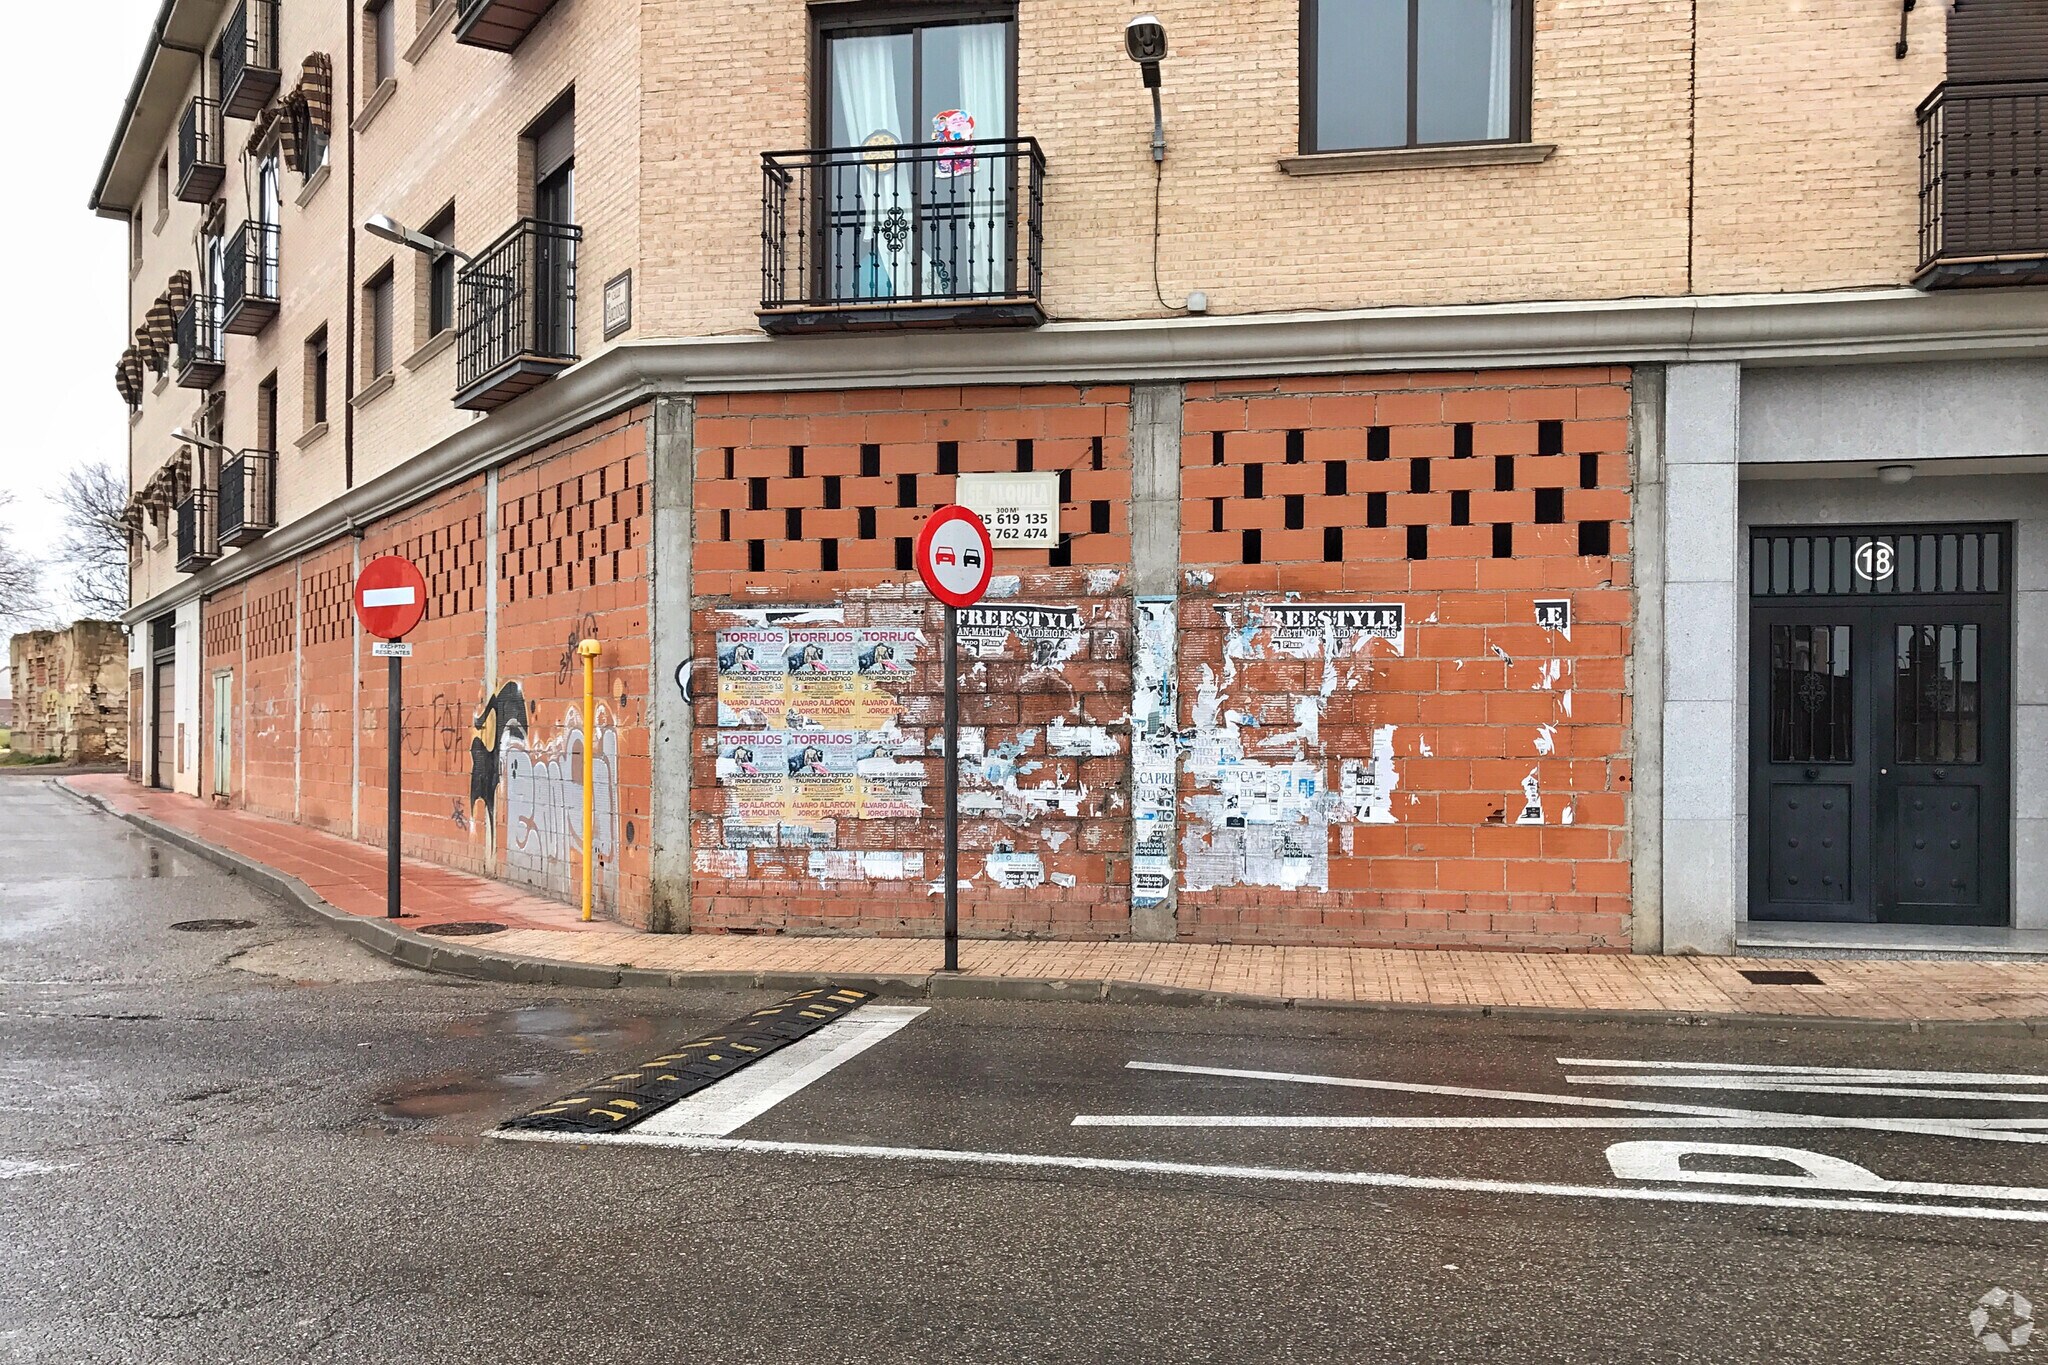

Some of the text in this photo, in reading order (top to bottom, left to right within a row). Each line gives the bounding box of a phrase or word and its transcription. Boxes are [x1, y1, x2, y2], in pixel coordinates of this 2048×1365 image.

[989, 482, 1048, 505] ALQUILA
[978, 513, 1048, 525] 95 619 135
[995, 528, 1020, 539] 762
[1024, 528, 1048, 539] 474
[1862, 548, 1890, 574] 18
[1272, 610, 1398, 627] REESTYLE
[722, 632, 784, 642] TORRIJOS
[792, 632, 853, 642] TORRIJOS
[862, 631, 916, 641] TORRIJO
[723, 735, 782, 745] TORRIJOS
[792, 735, 853, 744] TORRIJOS
